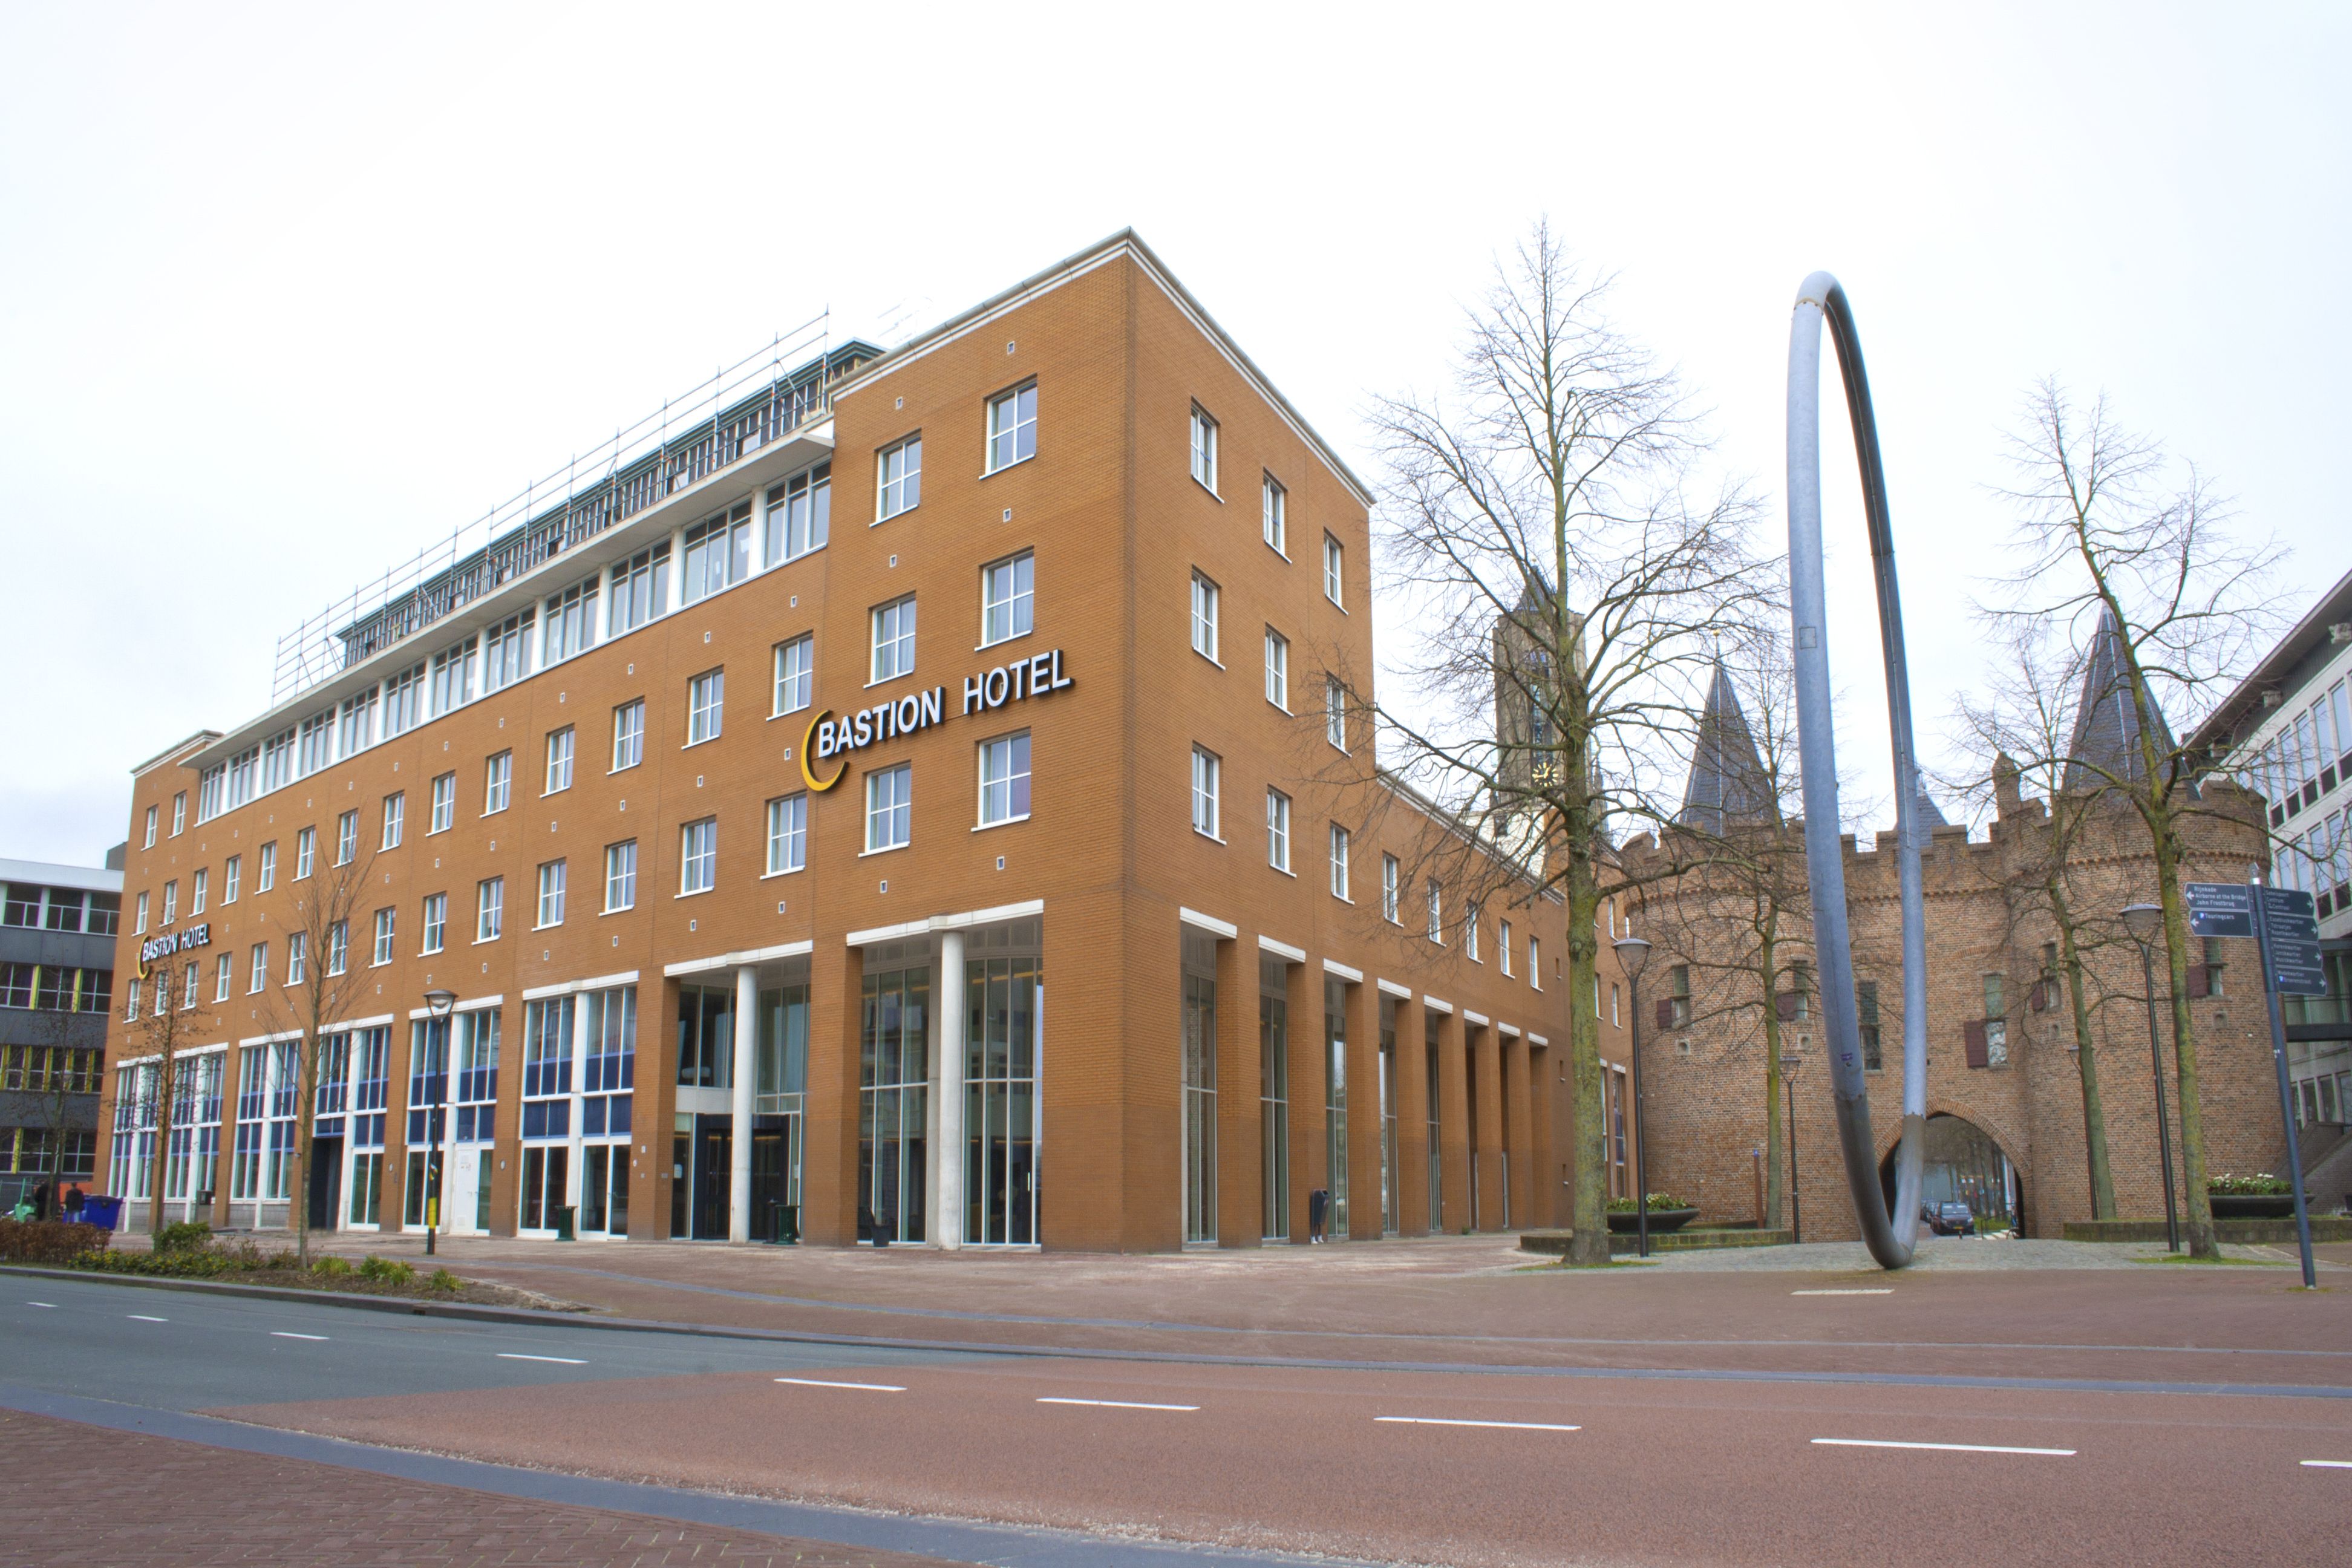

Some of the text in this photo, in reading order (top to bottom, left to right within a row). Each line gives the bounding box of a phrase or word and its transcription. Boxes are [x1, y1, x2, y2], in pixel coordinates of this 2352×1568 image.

[818, 649, 1073, 758] BASTION HOTEL
[142, 923, 209, 962] BASTION HOTEL
